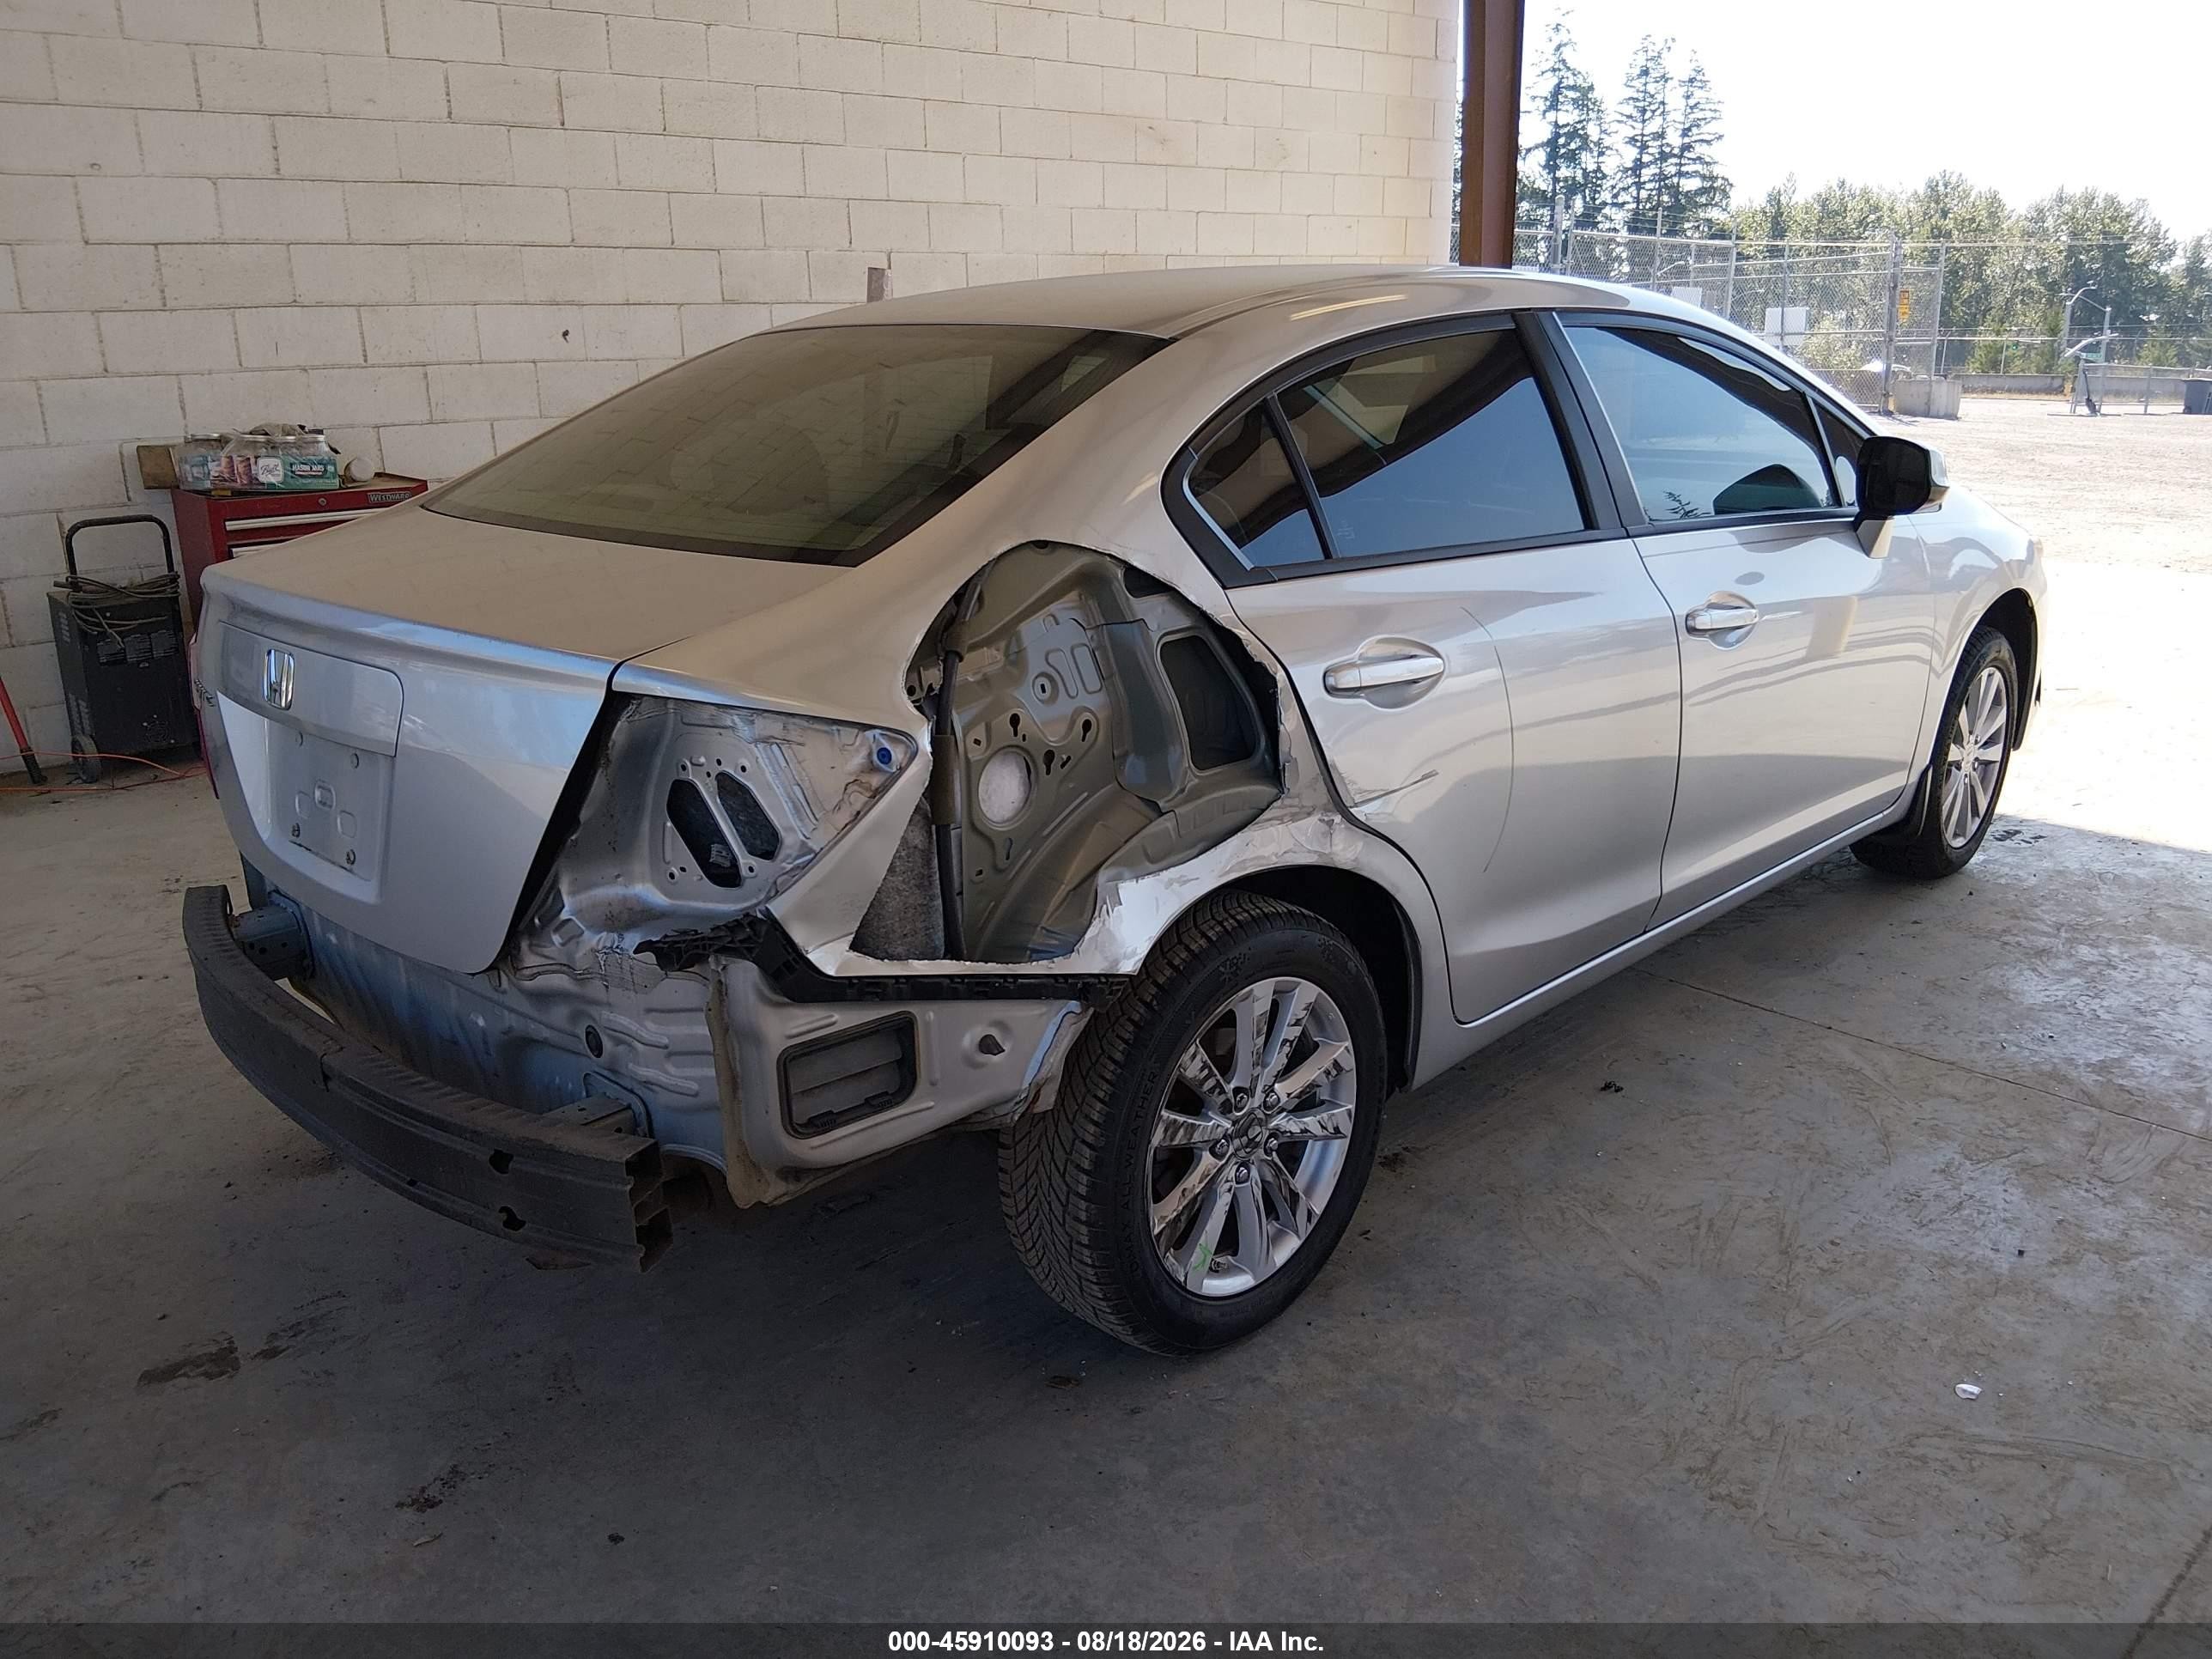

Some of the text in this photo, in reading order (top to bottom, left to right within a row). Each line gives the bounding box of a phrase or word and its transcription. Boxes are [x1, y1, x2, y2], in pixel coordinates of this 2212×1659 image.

[369, 493, 411, 502] WESTWARD
[1125, 1070, 1158, 1170] WEATHER
[1121, 1174, 1132, 1211] ALL
